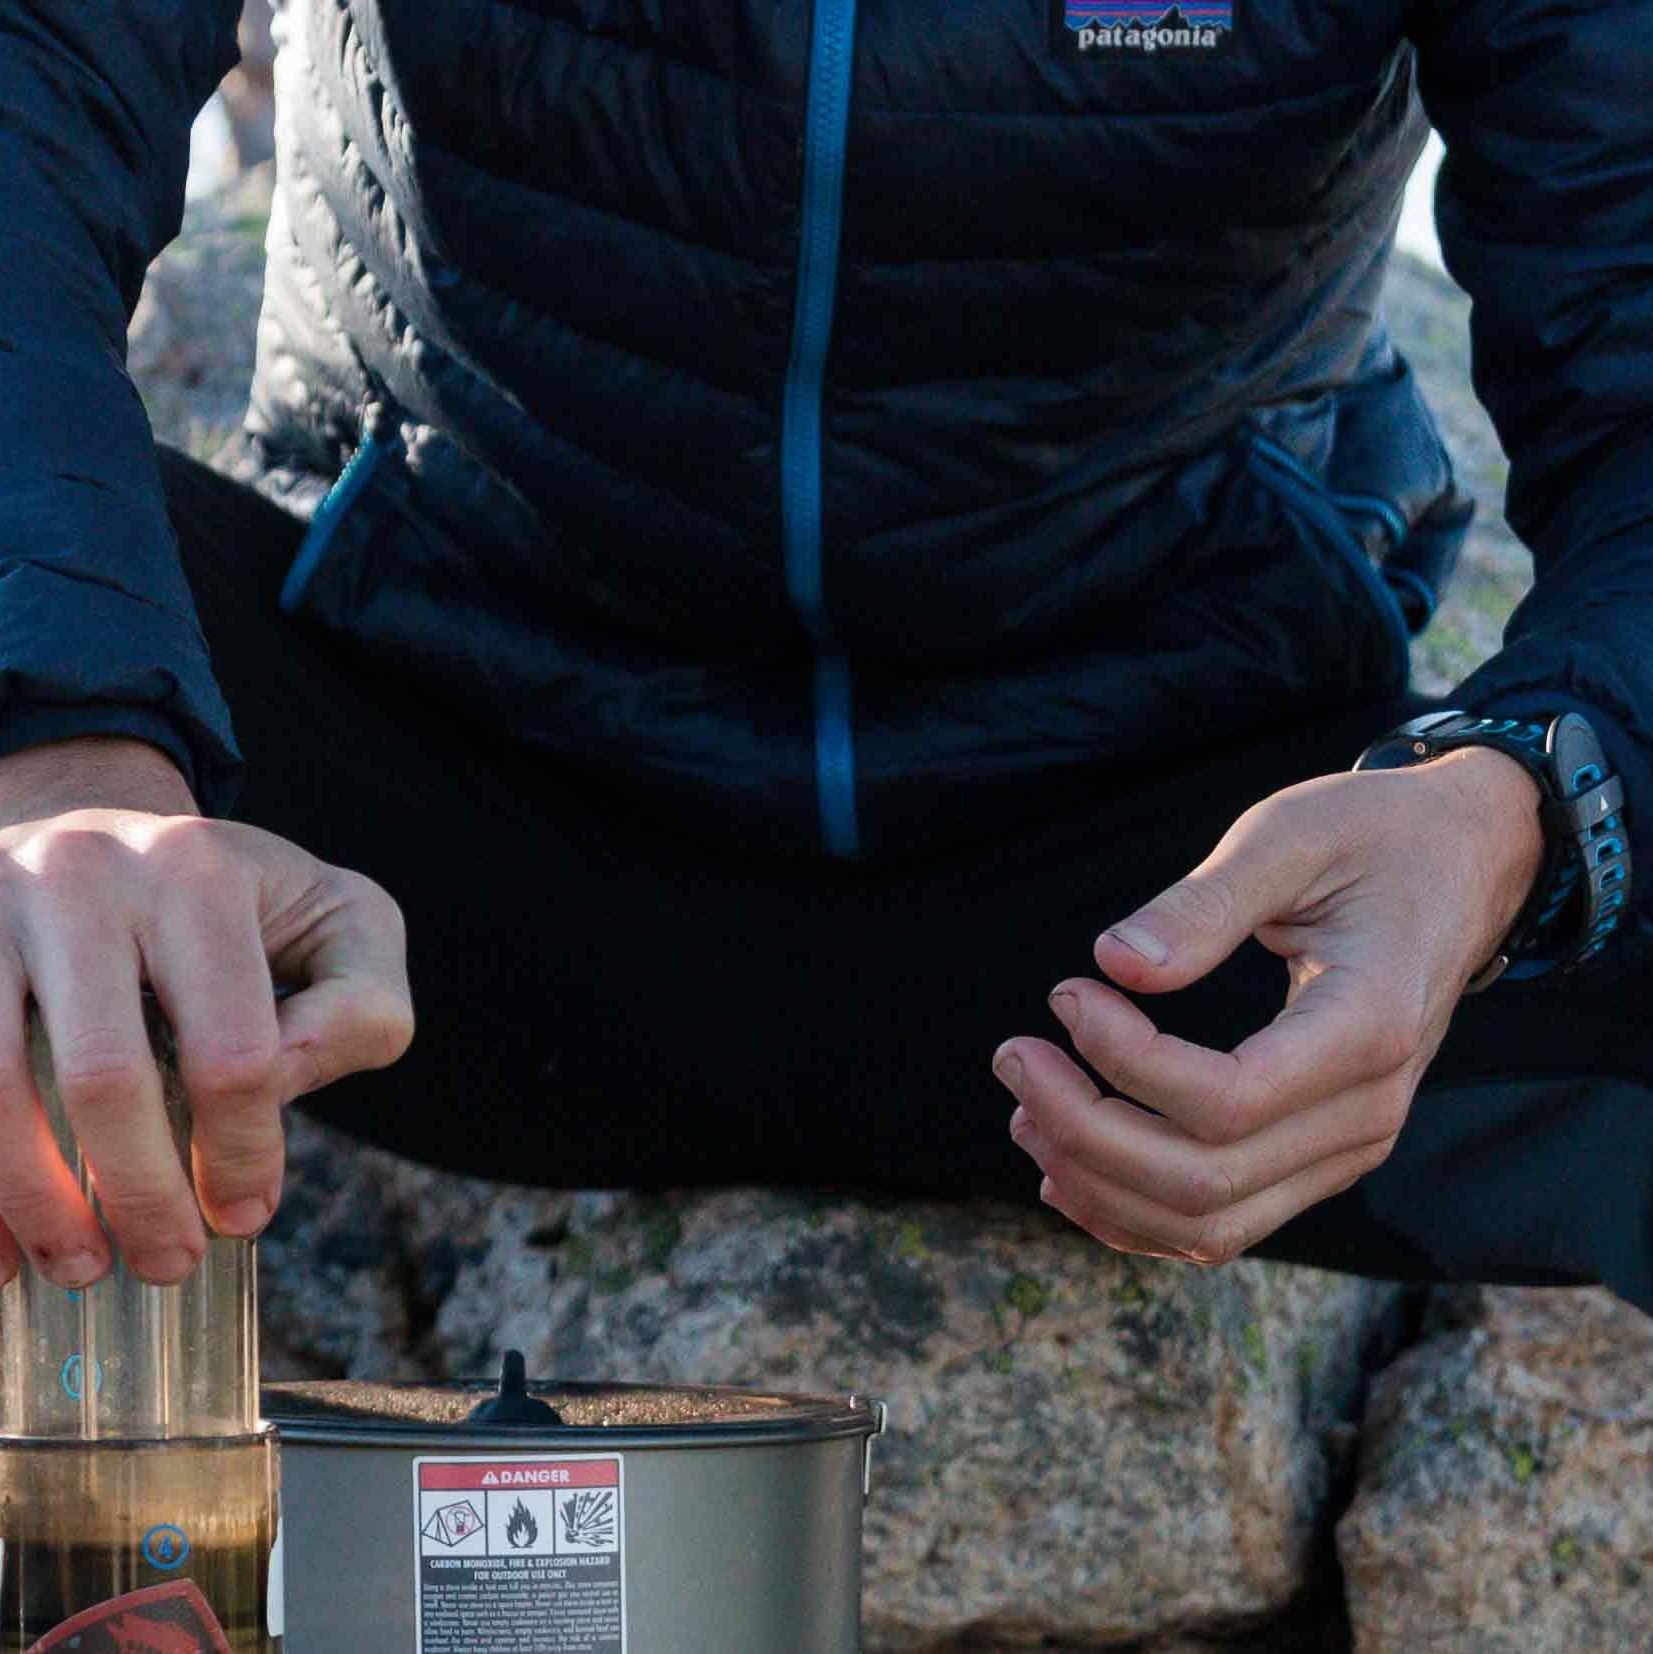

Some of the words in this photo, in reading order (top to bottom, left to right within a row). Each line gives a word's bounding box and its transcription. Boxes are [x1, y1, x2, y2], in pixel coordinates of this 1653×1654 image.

[1078, 26, 1217, 51] patagonia
[500, 1469, 570, 1484] DANGER
[474, 1570, 490, 1580] FOR
